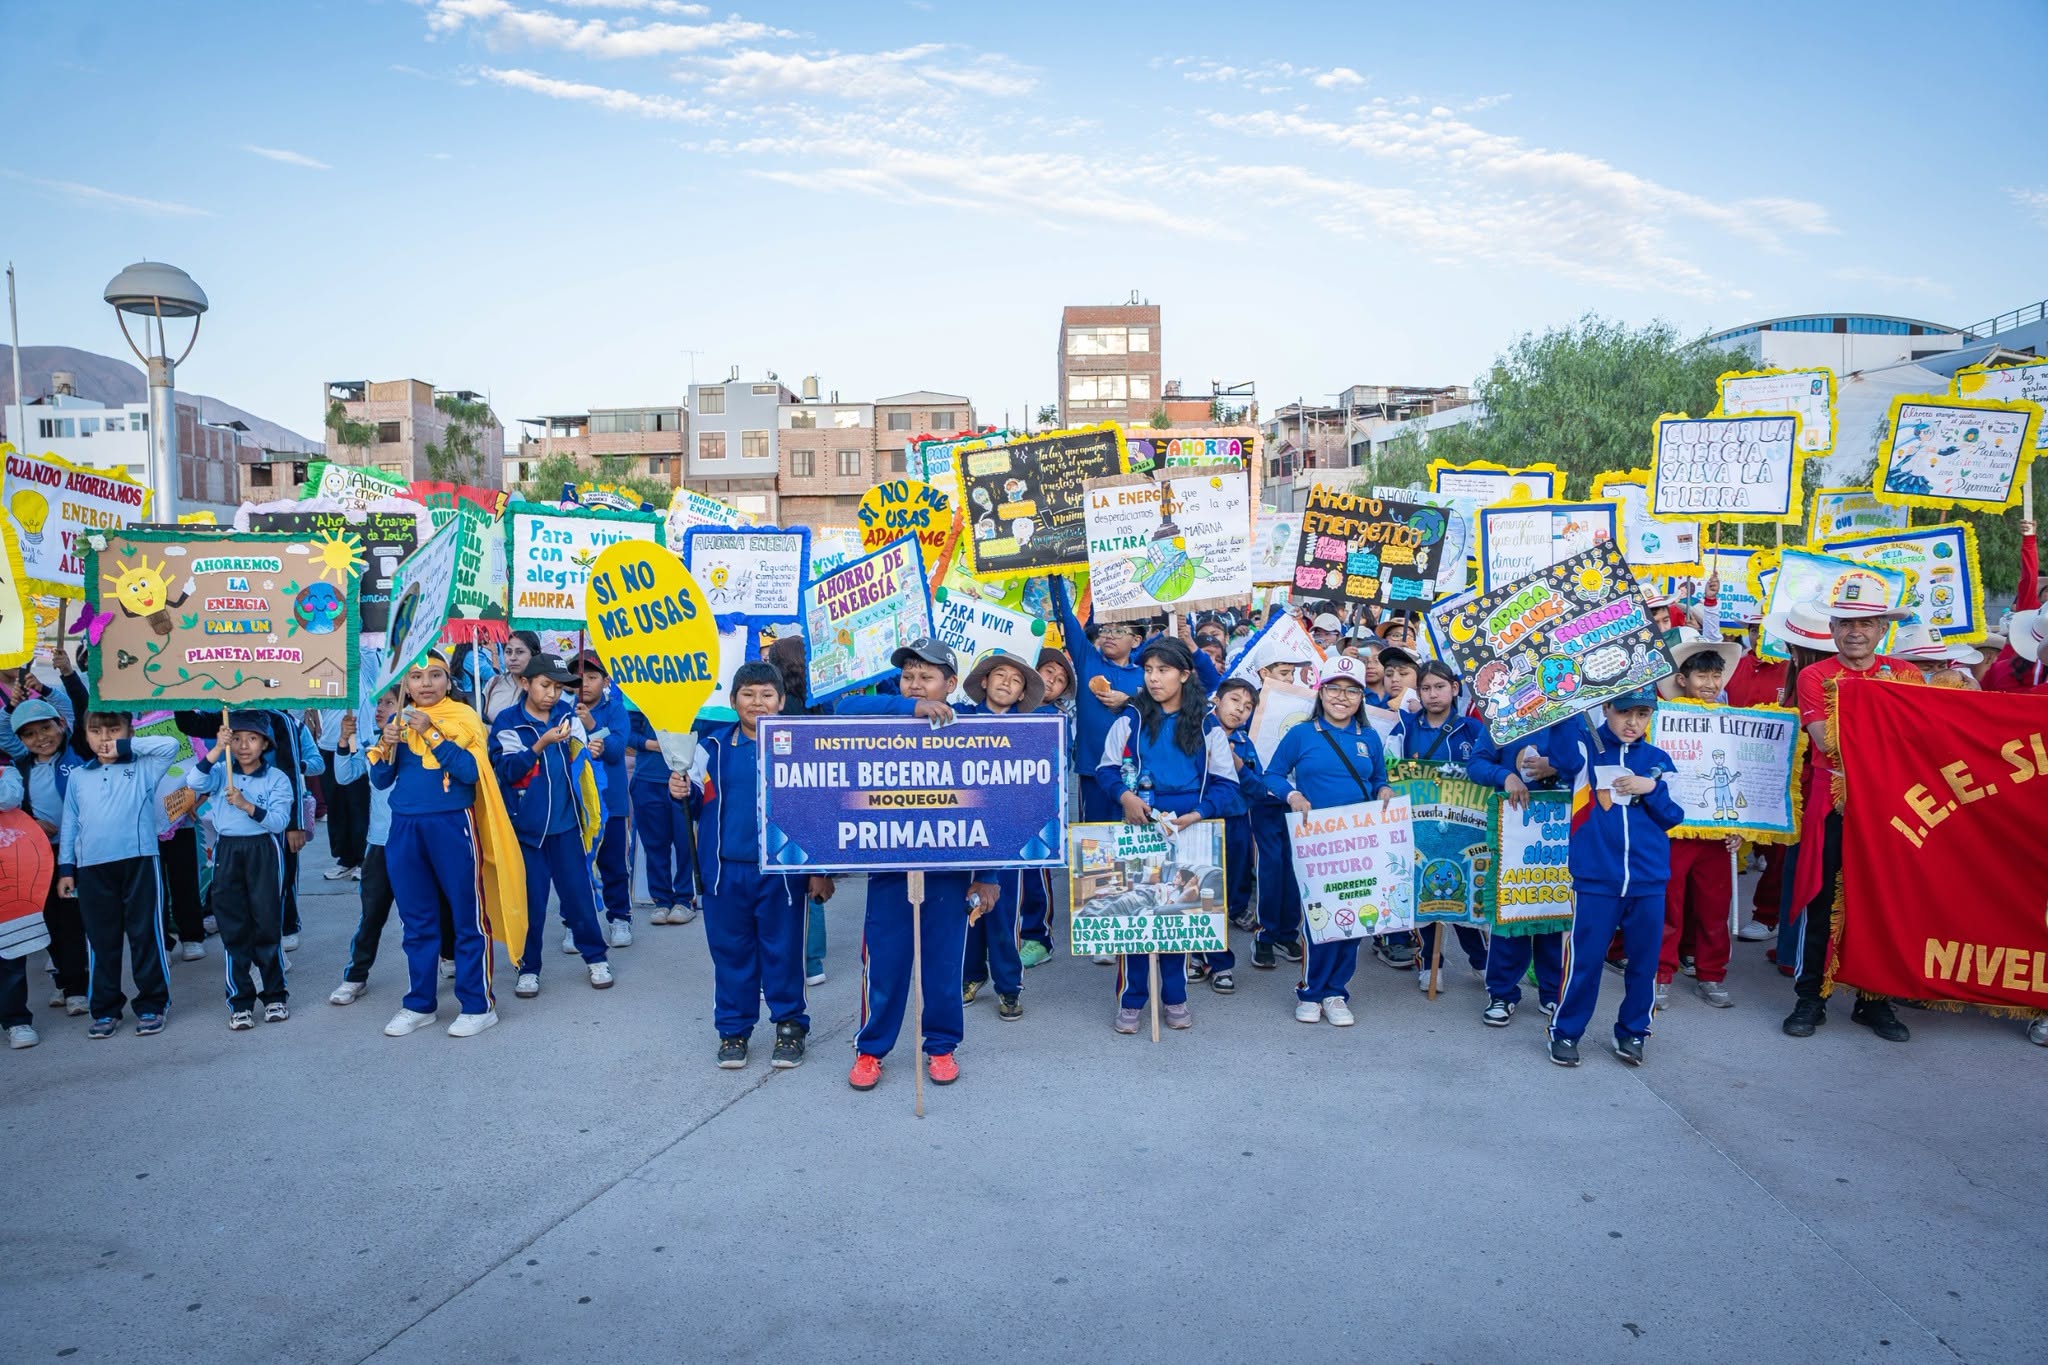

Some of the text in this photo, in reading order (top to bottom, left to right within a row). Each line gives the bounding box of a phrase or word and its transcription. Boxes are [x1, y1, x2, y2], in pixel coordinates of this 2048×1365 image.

[1666, 421, 1792, 444] CUIDAR LA
[1168, 439, 1242, 456] AHORRA
[5, 455, 142, 507] CUANDO AHORRAMOS
[1661, 463, 1731, 483] SALVA
[687, 493, 739, 518] AHORRO DE
[858, 480, 949, 527] SI NO ME
[1092, 493, 1110, 509] LA
[1181, 490, 1197, 502] que
[1306, 482, 1383, 517] Ahorro
[1662, 486, 1750, 508] TIERRA
[62, 502, 122, 530] ENERGIA
[690, 503, 728, 524] ENERGIA
[885, 508, 931, 529] USAS
[1094, 508, 1154, 525] desperdiciamos
[1209, 499, 1220, 509] la
[1226, 498, 1240, 510] que
[531, 520, 573, 544] Para
[1117, 525, 1133, 535] nos
[1184, 521, 1224, 537] MAÑANA
[694, 536, 745, 551] AHORRA
[1090, 528, 1149, 554] FALTARÁ
[1862, 543, 1925, 559] EL USO RACIONAL
[529, 548, 563, 562] con
[1882, 550, 1903, 559] DE LA
[194, 559, 280, 573] AHORREMOS
[817, 548, 904, 605] AHORRO DE
[229, 579, 248, 591] LA
[458, 570, 477, 588] SAS
[527, 565, 590, 590] alegrí
[592, 561, 655, 605] SI NO
[828, 571, 897, 622] ENERGÍA
[1722, 584, 1734, 593] ES
[207, 599, 268, 610] ENERGIA
[518, 591, 575, 609] AHORRA
[1721, 602, 1734, 610] DE
[598, 588, 697, 641] ME USAS
[941, 599, 1014, 636] PARA VIVIR
[1489, 586, 1551, 636] APAGA
[1555, 599, 1633, 643] ENCIENDE
[207, 620, 270, 633] PARA UN
[1500, 625, 1527, 645] LA
[1563, 609, 1645, 655] EL FUTURO!
[188, 648, 301, 662] PLANETA MEJOR
[610, 652, 712, 685] APAGAME
[814, 734, 1011, 751] INSTITUCIÓN EDUCATIVA
[1679, 739, 1703, 750] ES LA
[774, 759, 1051, 788] DANIEL BECERRA OCAMPO
[868, 793, 958, 807] MOQUEGUA
[1890, 760, 1999, 849] I.E.E.
[1294, 806, 1409, 838] APAGA LA LUZ
[1523, 801, 1566, 827] Para
[838, 819, 990, 850] PRIMARIA
[1118, 833, 1163, 846] ME USAS
[1124, 826, 1135, 834] SI
[1118, 843, 1168, 857] APAGAME
[1296, 829, 1408, 859] ENCIENDE EL
[1306, 856, 1374, 878] FUTURO
[1325, 877, 1378, 893] AHORREMOS
[1073, 914, 1211, 930] APAGA LO QUE NO
[1073, 926, 1216, 942] USAS HOY, ILUMINA
[1073, 938, 1225, 955] EL FUTURO MAÑANA
[1924, 938, 2048, 995] NIVEL
